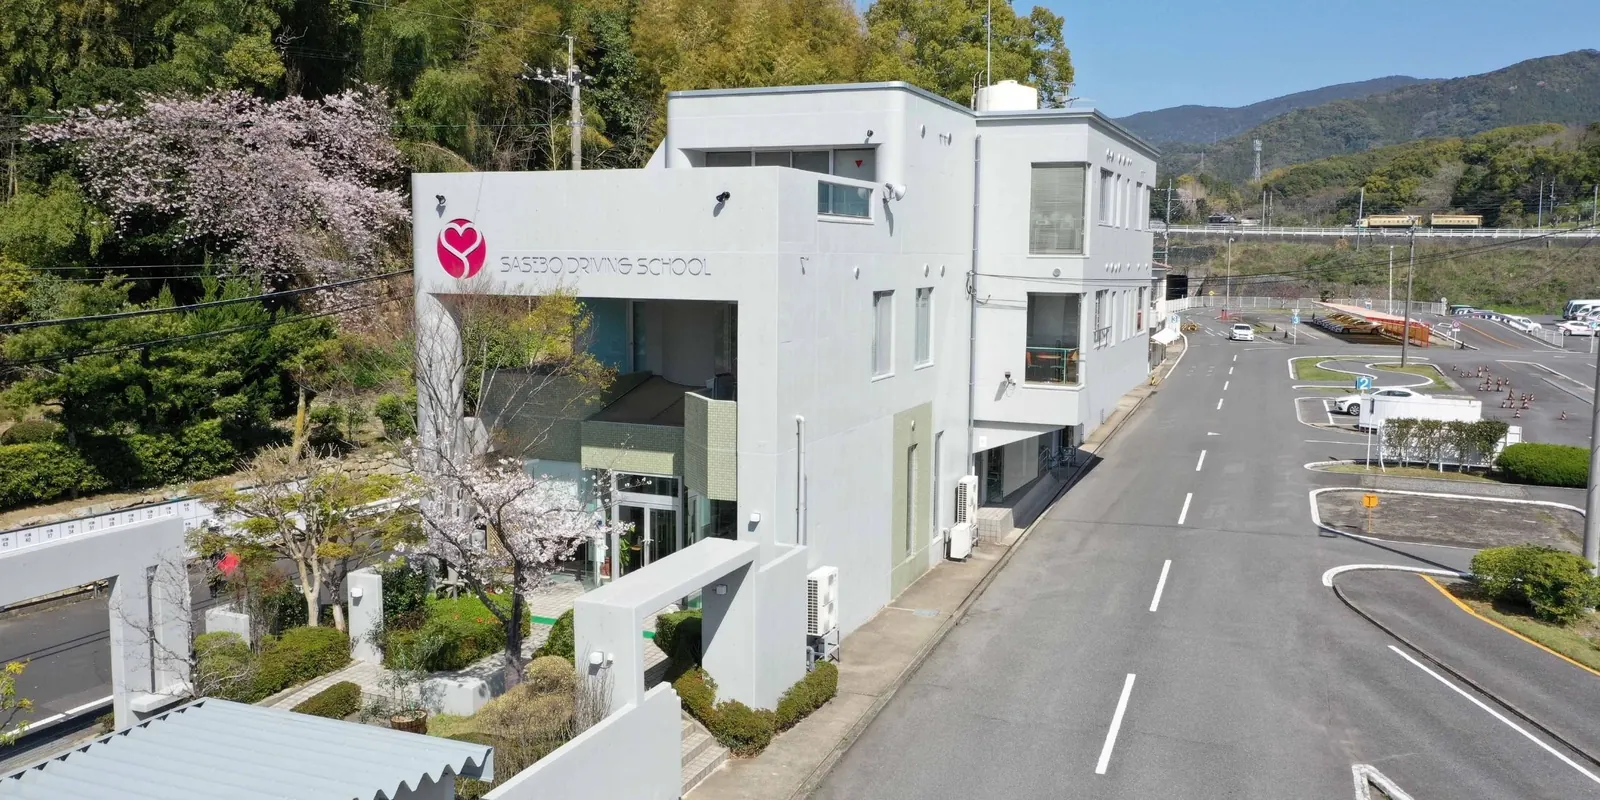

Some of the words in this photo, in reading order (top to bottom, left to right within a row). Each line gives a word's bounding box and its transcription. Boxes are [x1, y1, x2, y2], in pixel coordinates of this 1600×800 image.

[500, 256, 563, 274] SASEBO
[567, 257, 632, 275] DRIVING
[637, 257, 711, 276] SCHOOL
[1360, 377, 1369, 389] 2
